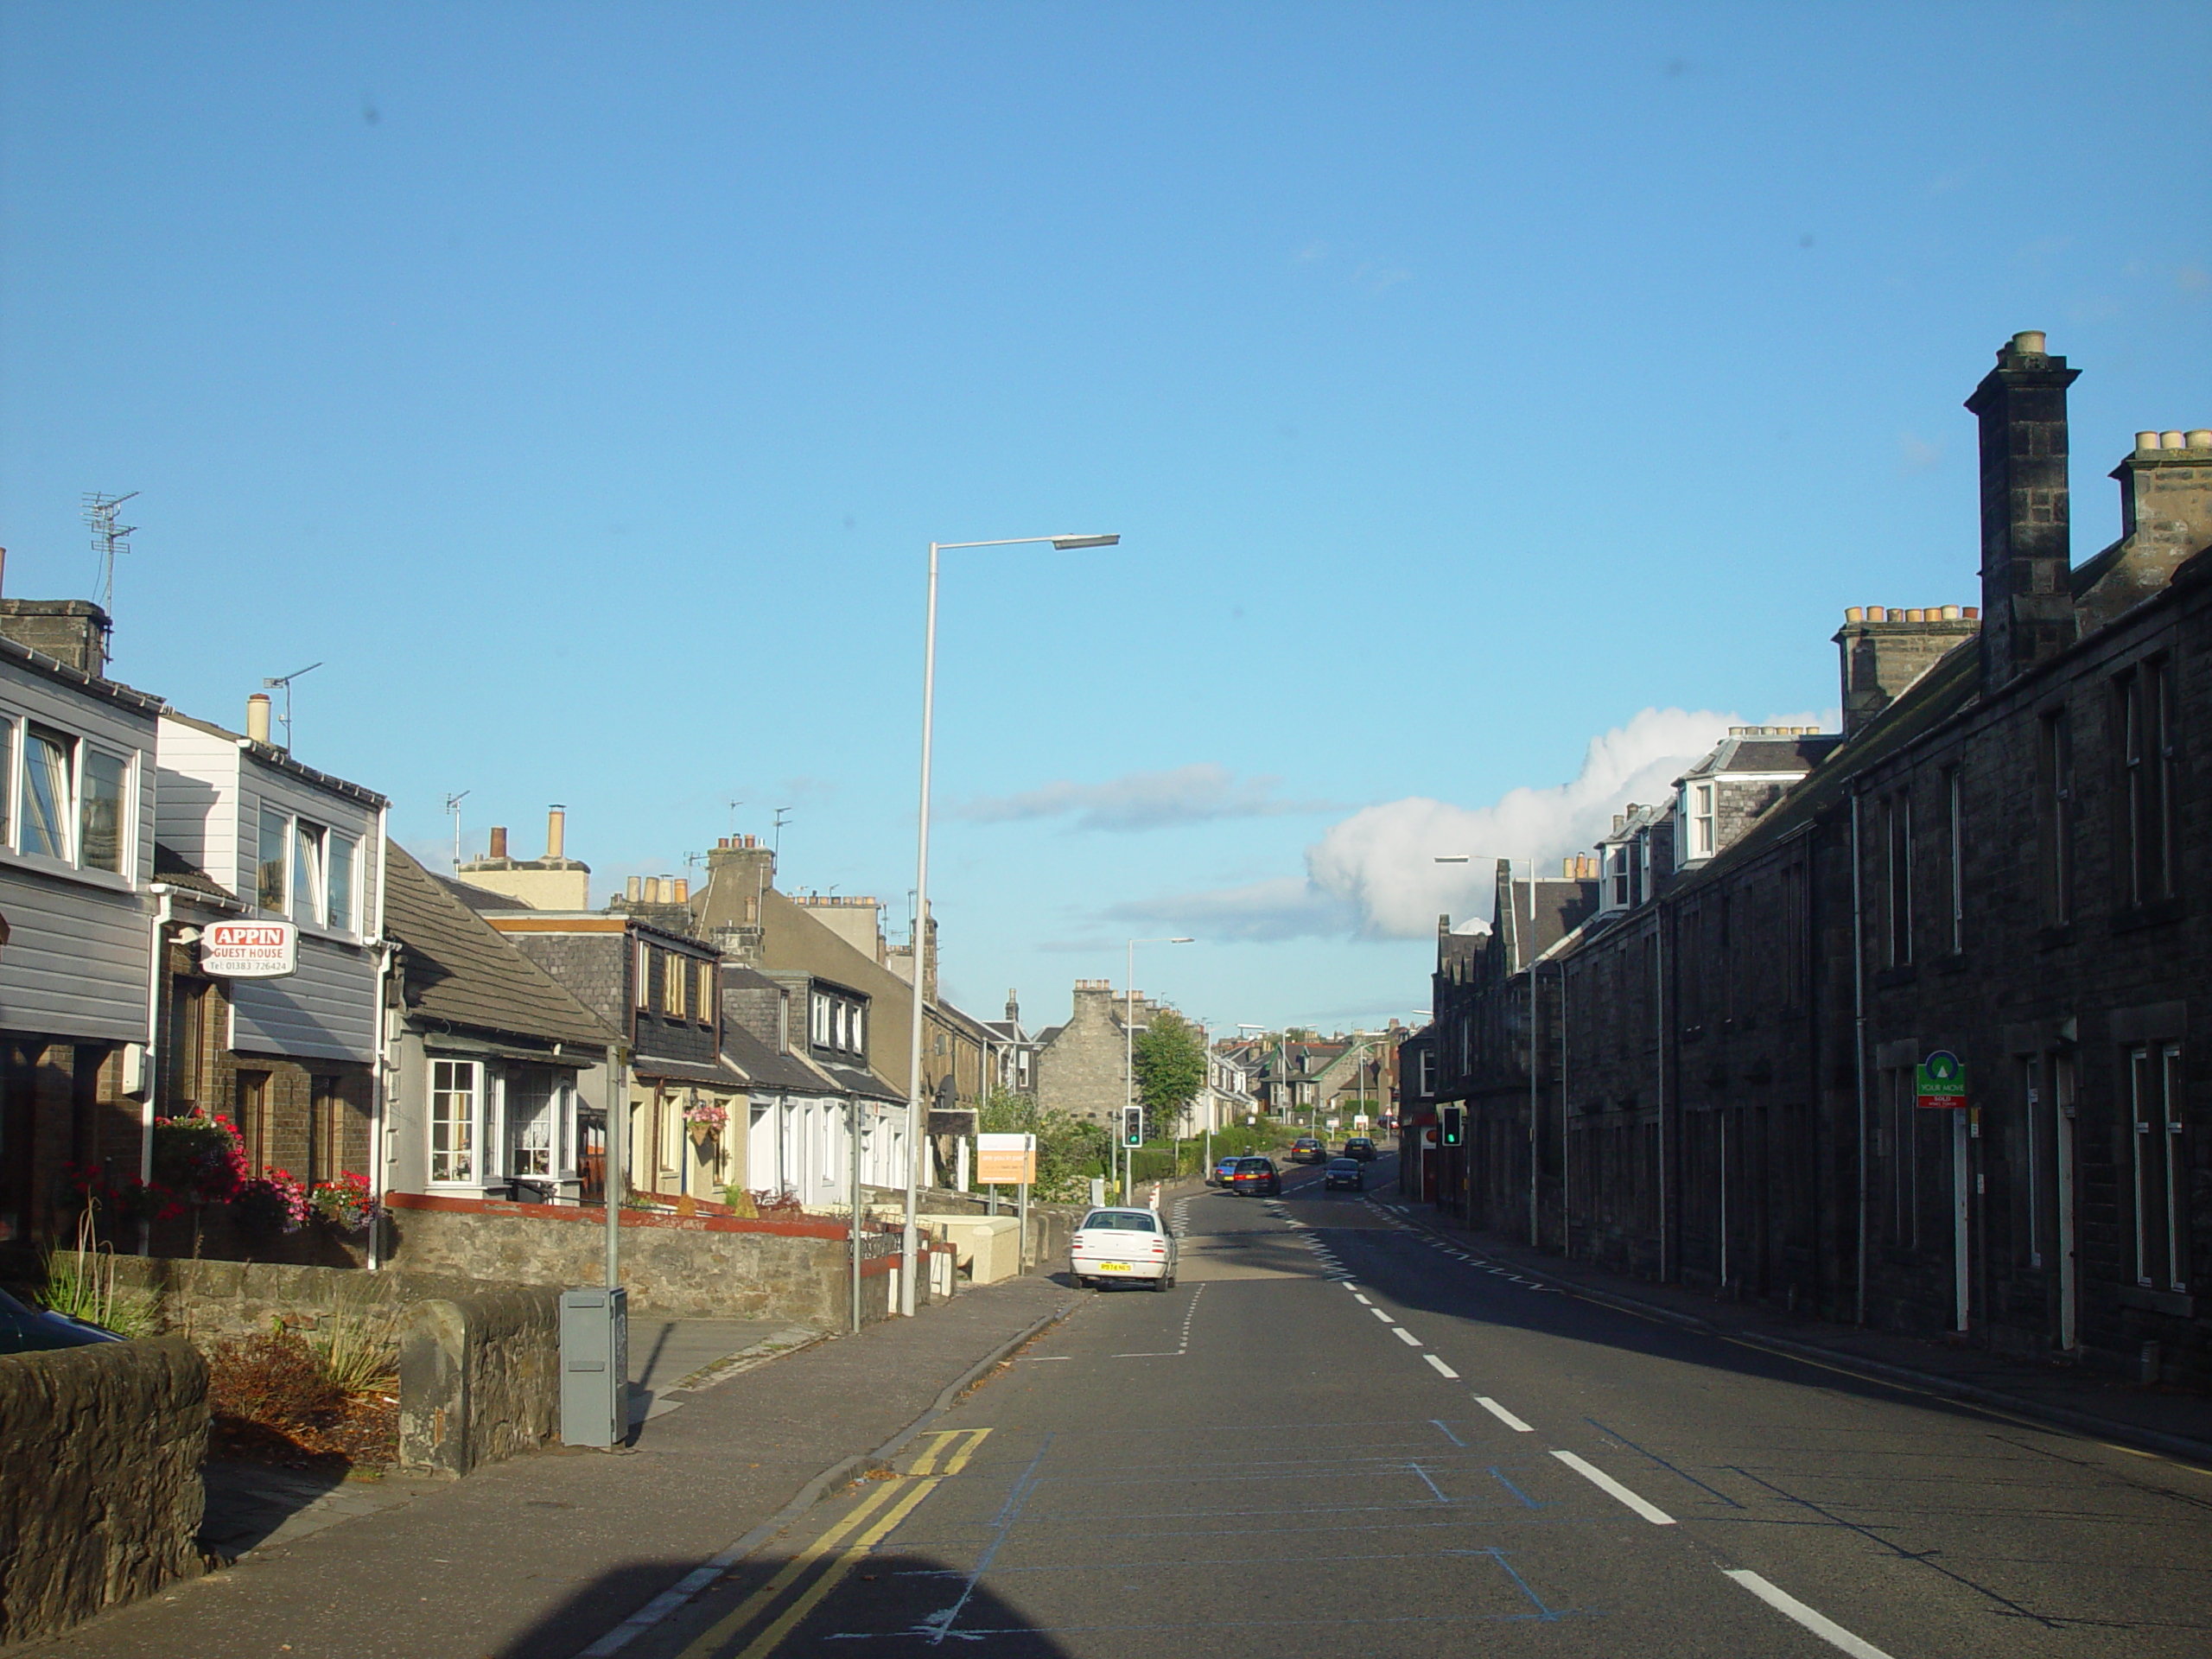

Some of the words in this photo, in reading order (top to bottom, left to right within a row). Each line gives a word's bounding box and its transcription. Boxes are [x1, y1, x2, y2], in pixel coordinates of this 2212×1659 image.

[217, 928, 281, 944] APPIN
[213, 948, 246, 958] GUEST
[249, 948, 283, 958] HOUSE
[226, 962, 251, 970] 01383
[255, 962, 287, 970] 726424
